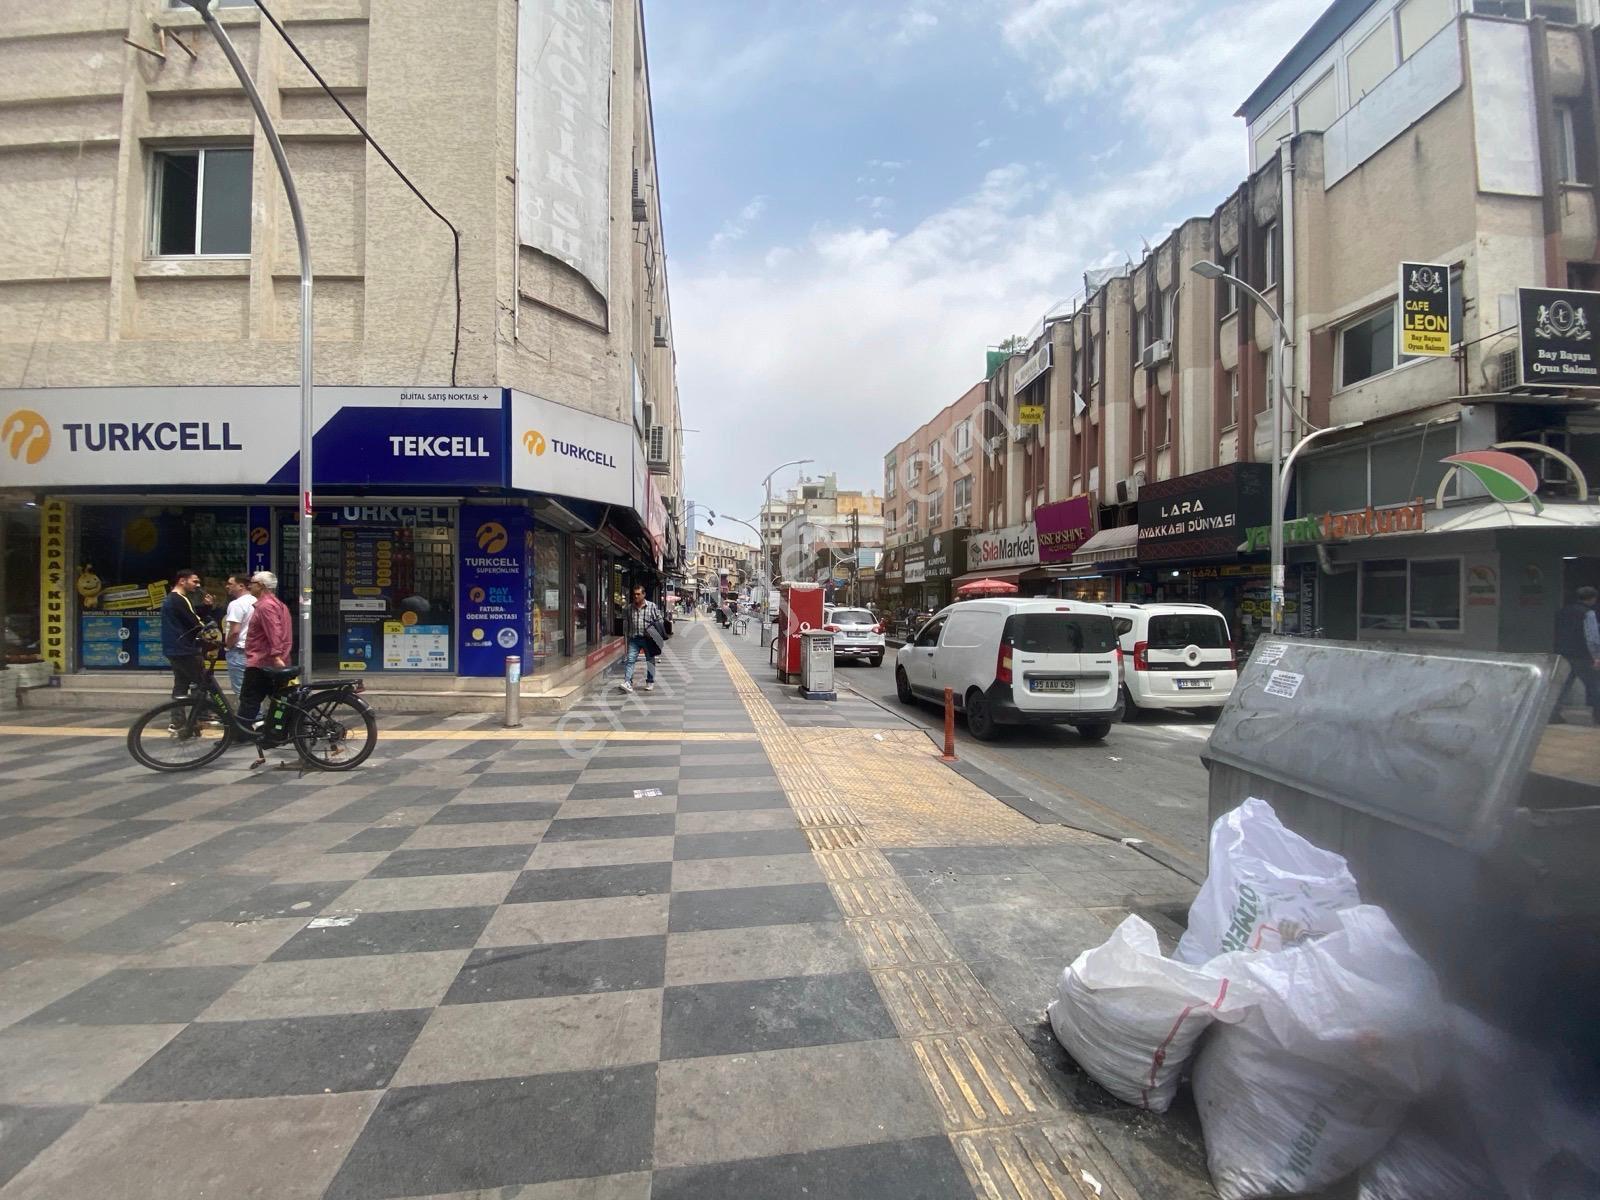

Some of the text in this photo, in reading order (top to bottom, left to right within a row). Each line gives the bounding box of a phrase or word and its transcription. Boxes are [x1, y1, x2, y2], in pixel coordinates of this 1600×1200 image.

[1405, 300, 1430, 311] CAFE
[1404, 313, 1448, 331] LEON
[1411, 334, 1442, 344] Bay Bayan
[1407, 343, 1445, 352] Oyun Salonu
[1538, 349, 1591, 362] Bay Bayan
[1532, 363, 1597, 375] Oyun Salonu
[427, 391, 447, 402] SATIŞ
[448, 391, 479, 401] NOKTASI
[63, 422, 242, 452] TURKCELL
[389, 436, 490, 458] TEKCELL
[551, 438, 617, 469] TURKCELL
[1161, 499, 1204, 518] LARA
[1138, 513, 1236, 539] AYAKKABI DÜNYASI
[464, 557, 520, 567] TURKCELL
[476, 567, 520, 575] SUPERONLINE
[47, 502, 62, 671] ARKADAŞ KUNDURA
[489, 587, 509, 596] PAY
[489, 595, 515, 604] CELL
[466, 612, 489, 620] ÖDEME
